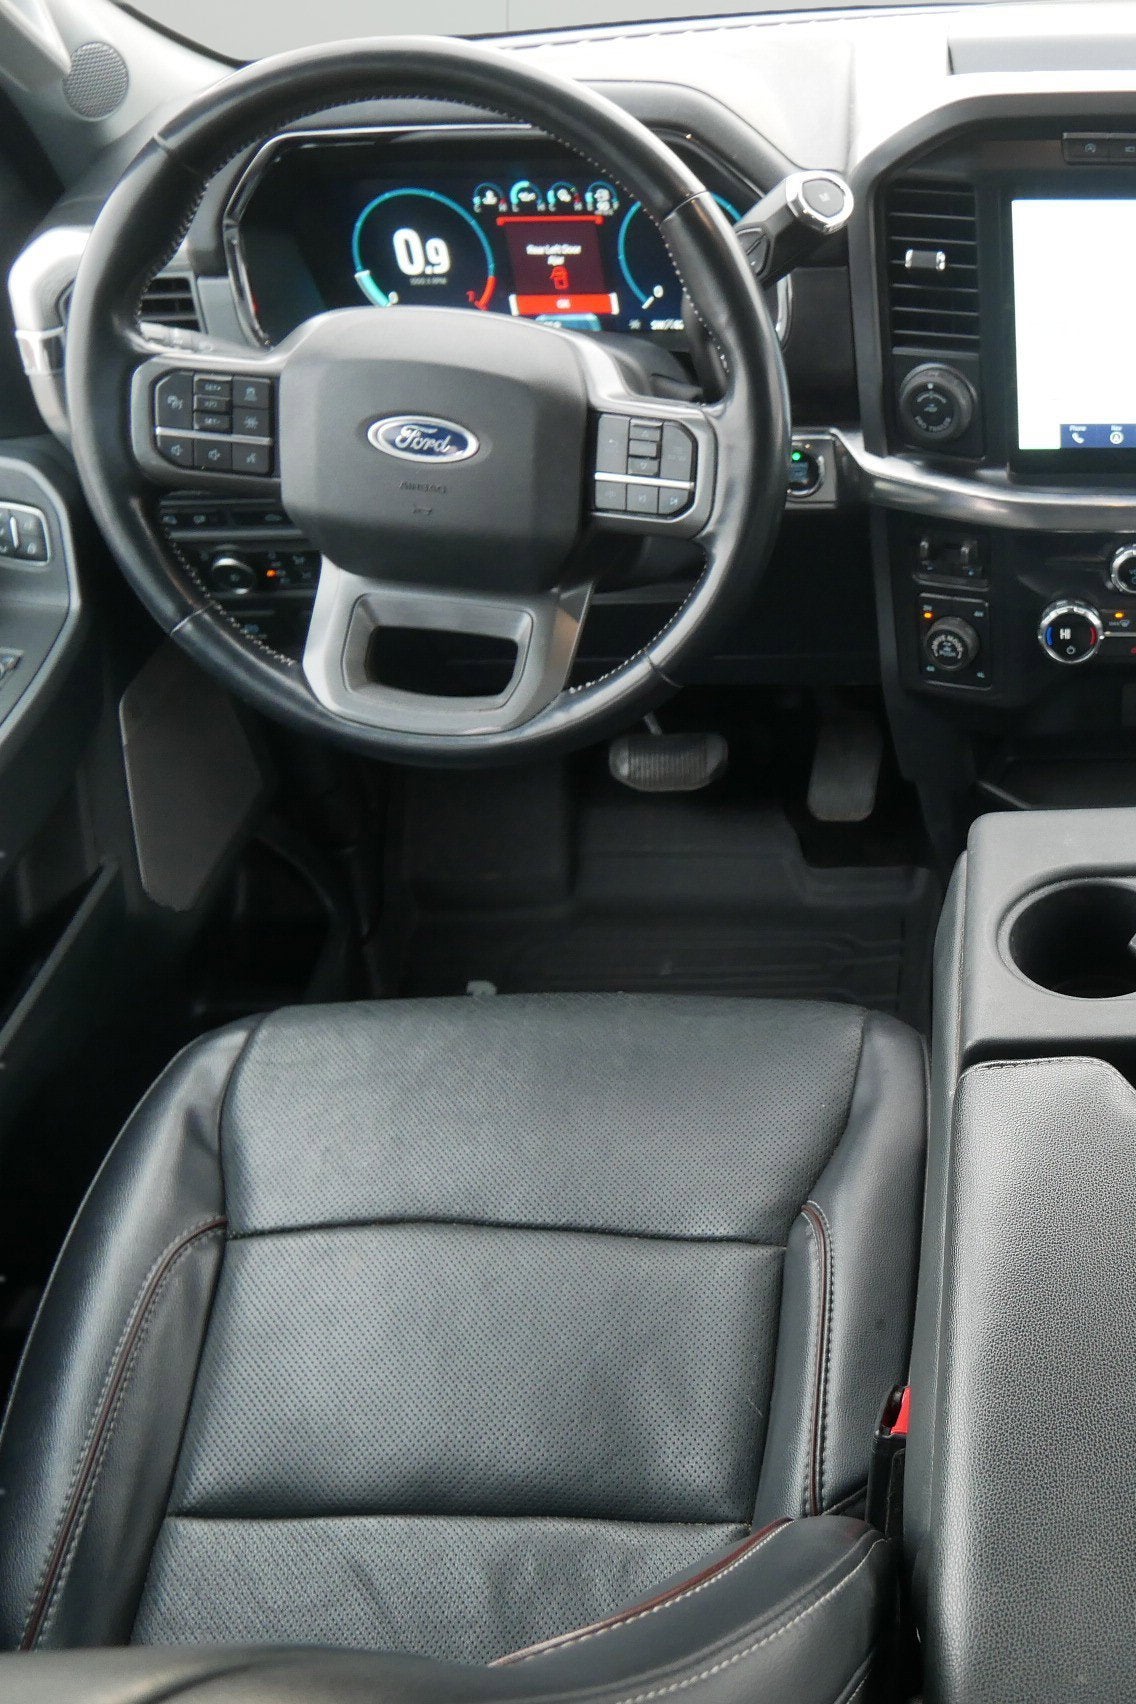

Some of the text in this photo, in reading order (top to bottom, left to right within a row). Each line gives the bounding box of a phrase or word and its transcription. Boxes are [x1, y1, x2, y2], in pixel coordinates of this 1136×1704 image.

[393, 228, 450, 276] 0.9
[394, 424, 452, 454] Ford
[1059, 628, 1071, 640] HI
